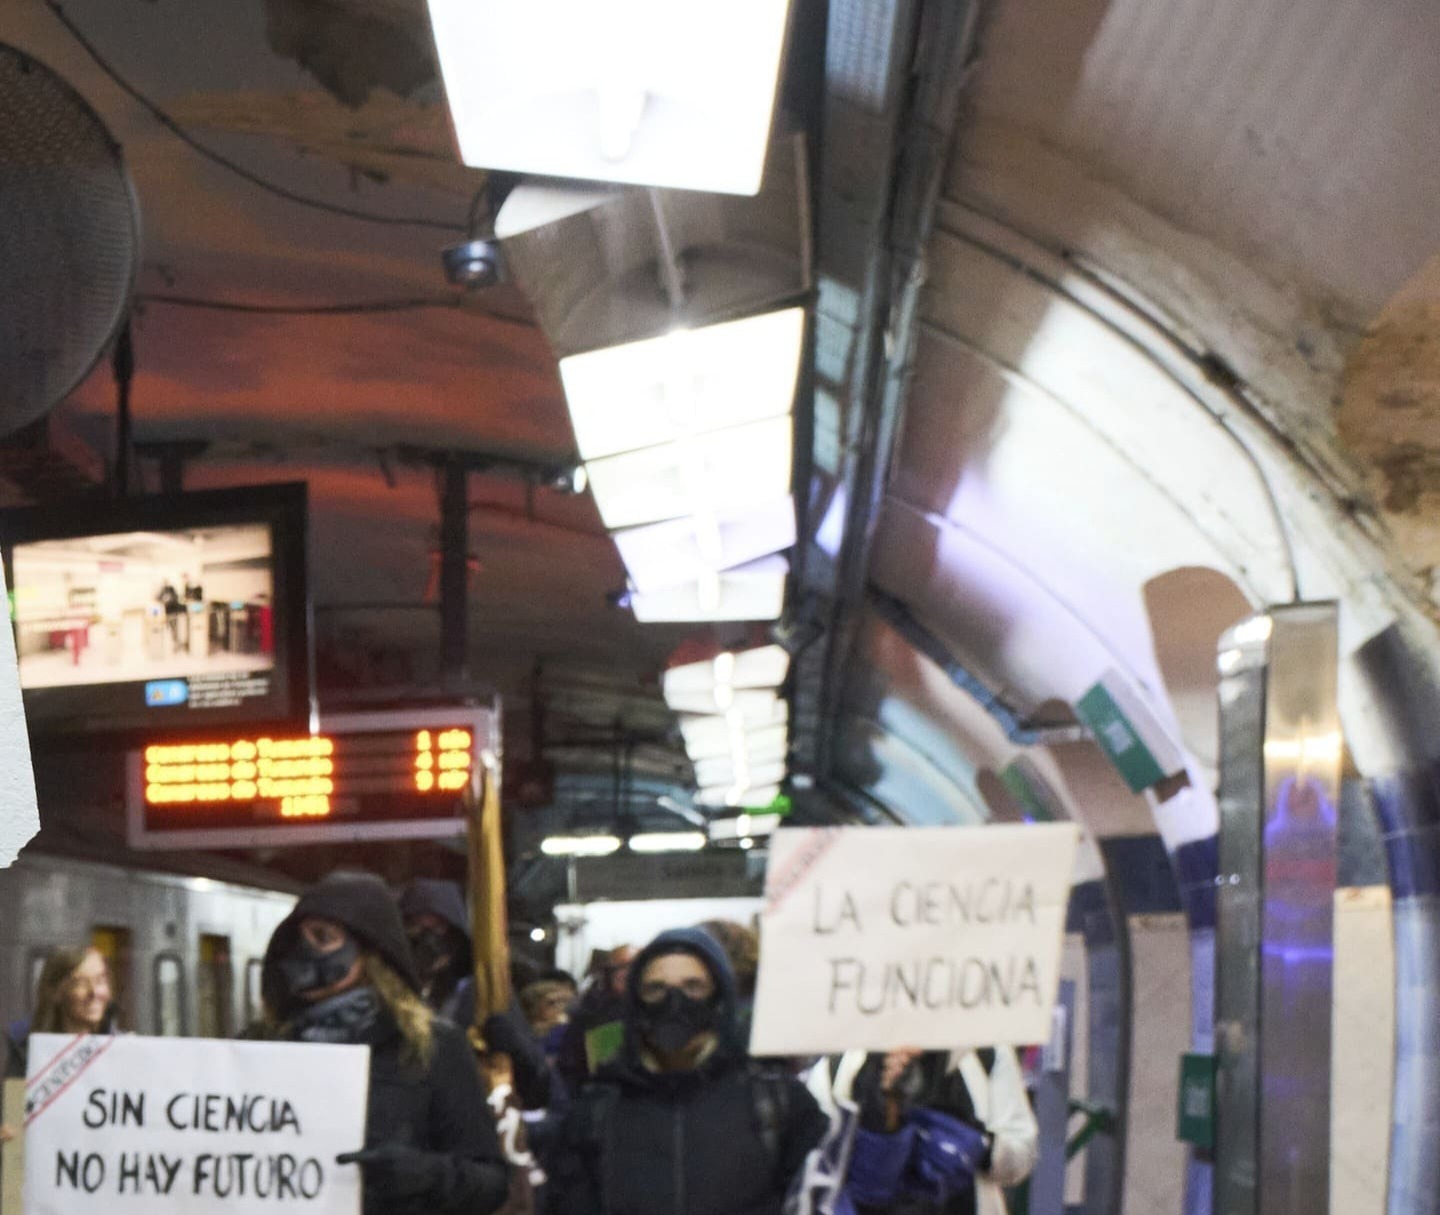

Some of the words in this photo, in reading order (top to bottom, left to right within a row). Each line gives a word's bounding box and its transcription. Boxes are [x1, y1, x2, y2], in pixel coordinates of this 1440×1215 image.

[812, 882, 861, 935] LA
[889, 878, 1037, 929] CIENCIA
[828, 956, 1041, 1016] FUNCIONA
[83, 1088, 145, 1130] SIN
[165, 1093, 301, 1134] CIENCIA
[55, 1150, 106, 1194] NO
[118, 1152, 183, 1195] HAY
[192, 1152, 325, 1200] FUTURO
